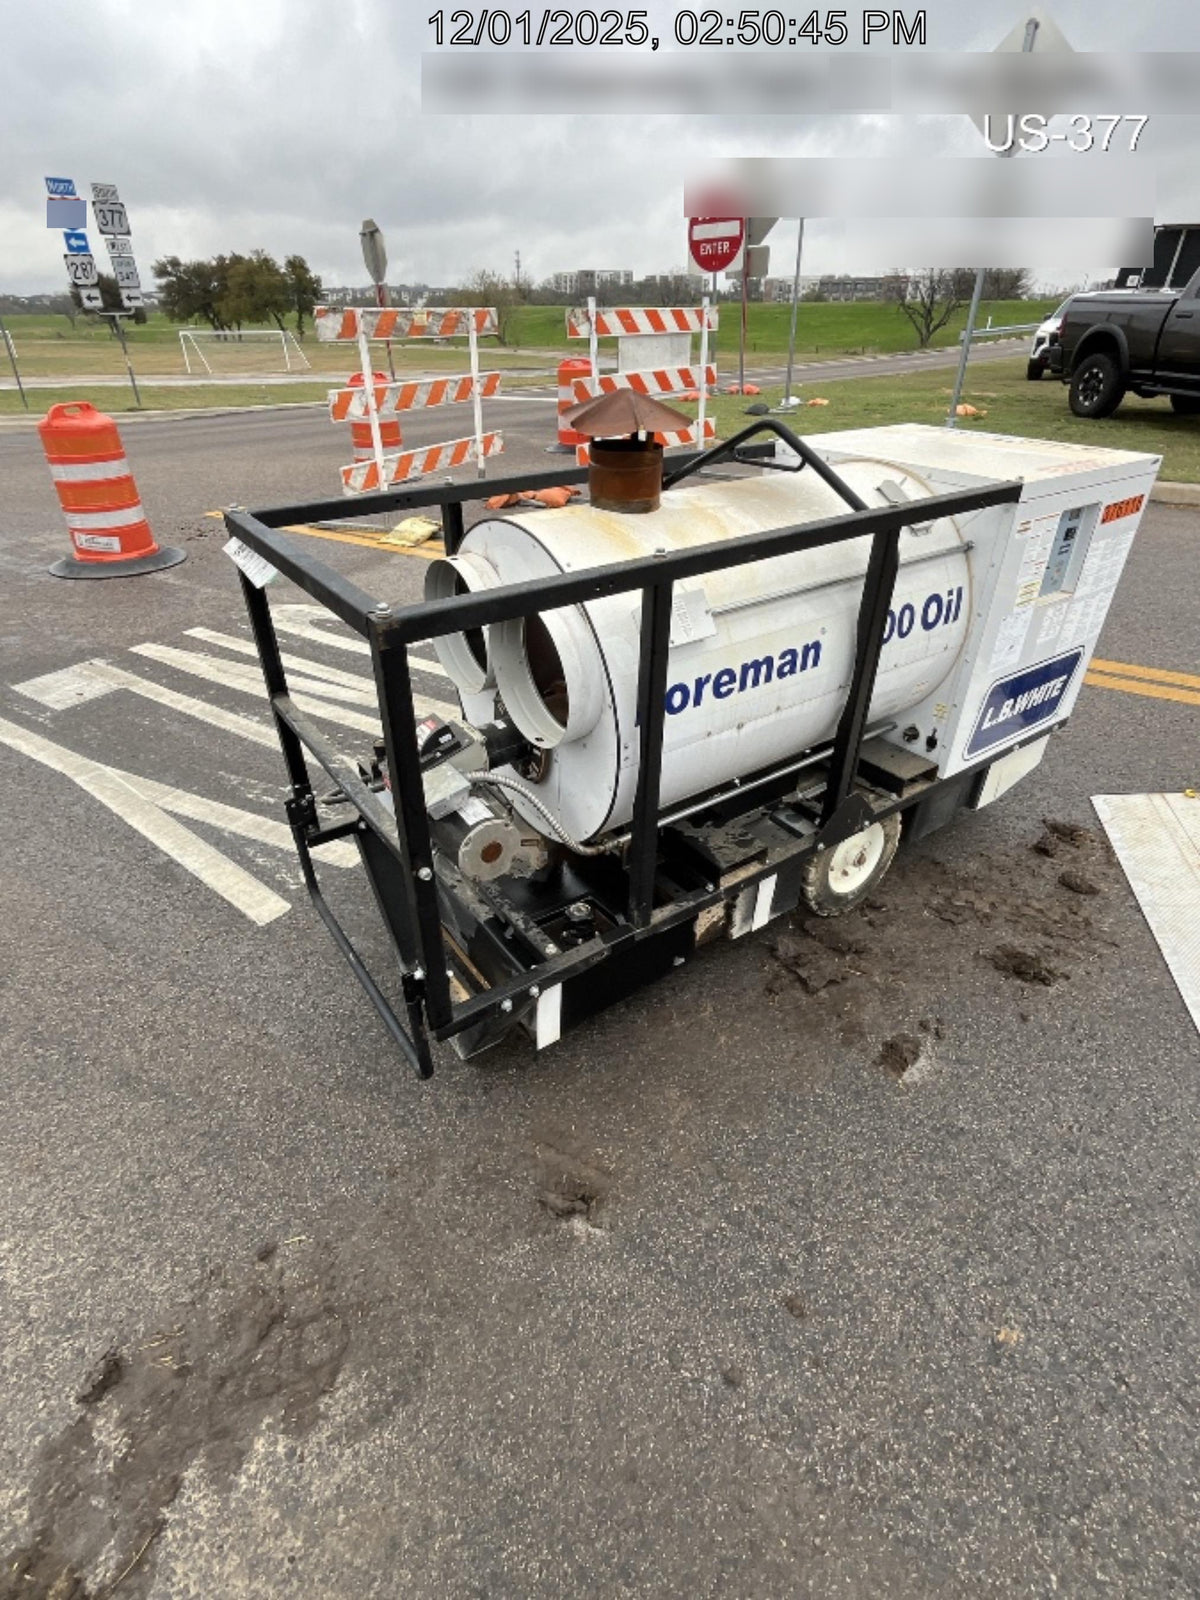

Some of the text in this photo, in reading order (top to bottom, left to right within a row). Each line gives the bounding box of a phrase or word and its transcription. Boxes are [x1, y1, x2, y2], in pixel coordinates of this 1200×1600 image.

[98, 209, 124, 228] 377
[701, 242, 730, 256] ENTER
[640, 640, 822, 720] oreman
[921, 585, 963, 632] Oil
